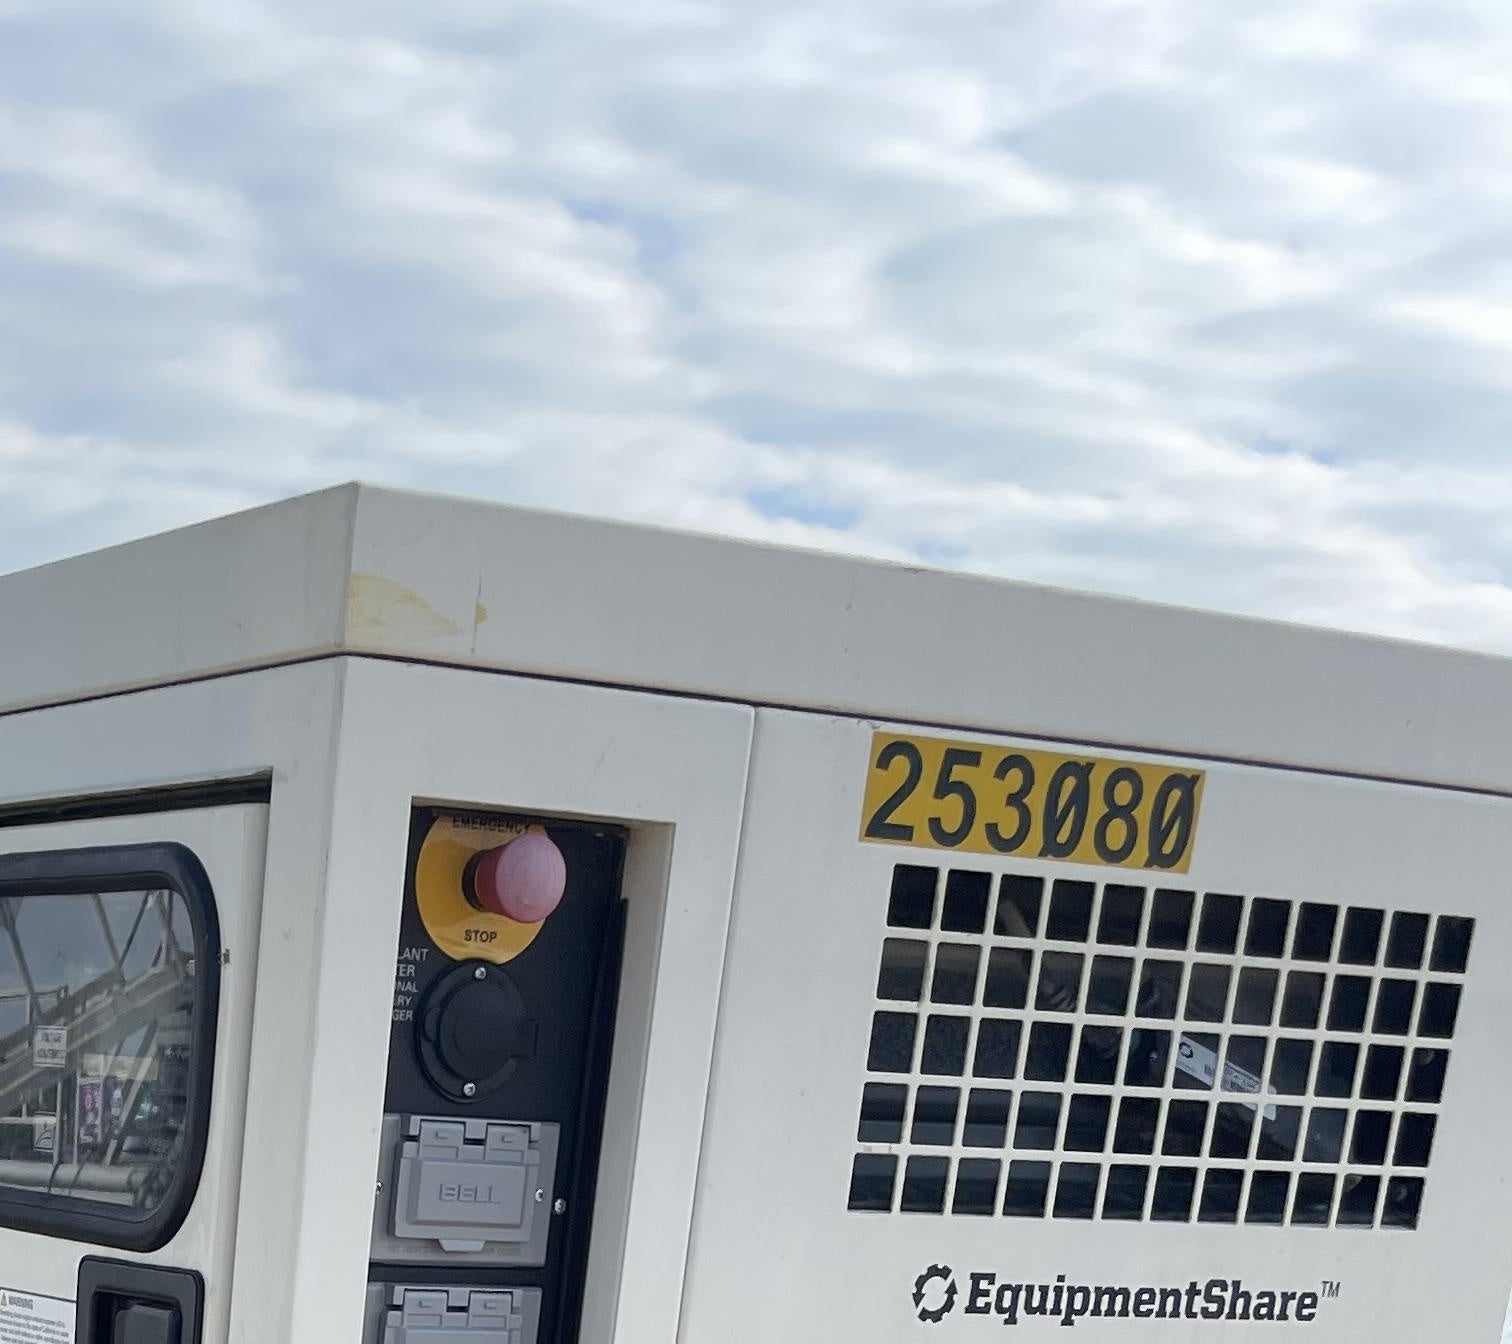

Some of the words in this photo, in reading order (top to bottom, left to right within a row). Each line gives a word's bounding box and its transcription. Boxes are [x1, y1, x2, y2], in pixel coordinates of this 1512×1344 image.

[866, 741, 1202, 870] 253080
[451, 815, 530, 834] EMERGENCY
[464, 928, 497, 943] STOP
[398, 947, 429, 961] ANT
[397, 964, 416, 977] ER
[395, 981, 418, 993] NAL
[395, 994, 412, 1007] RY
[439, 1182, 503, 1204] BELL
